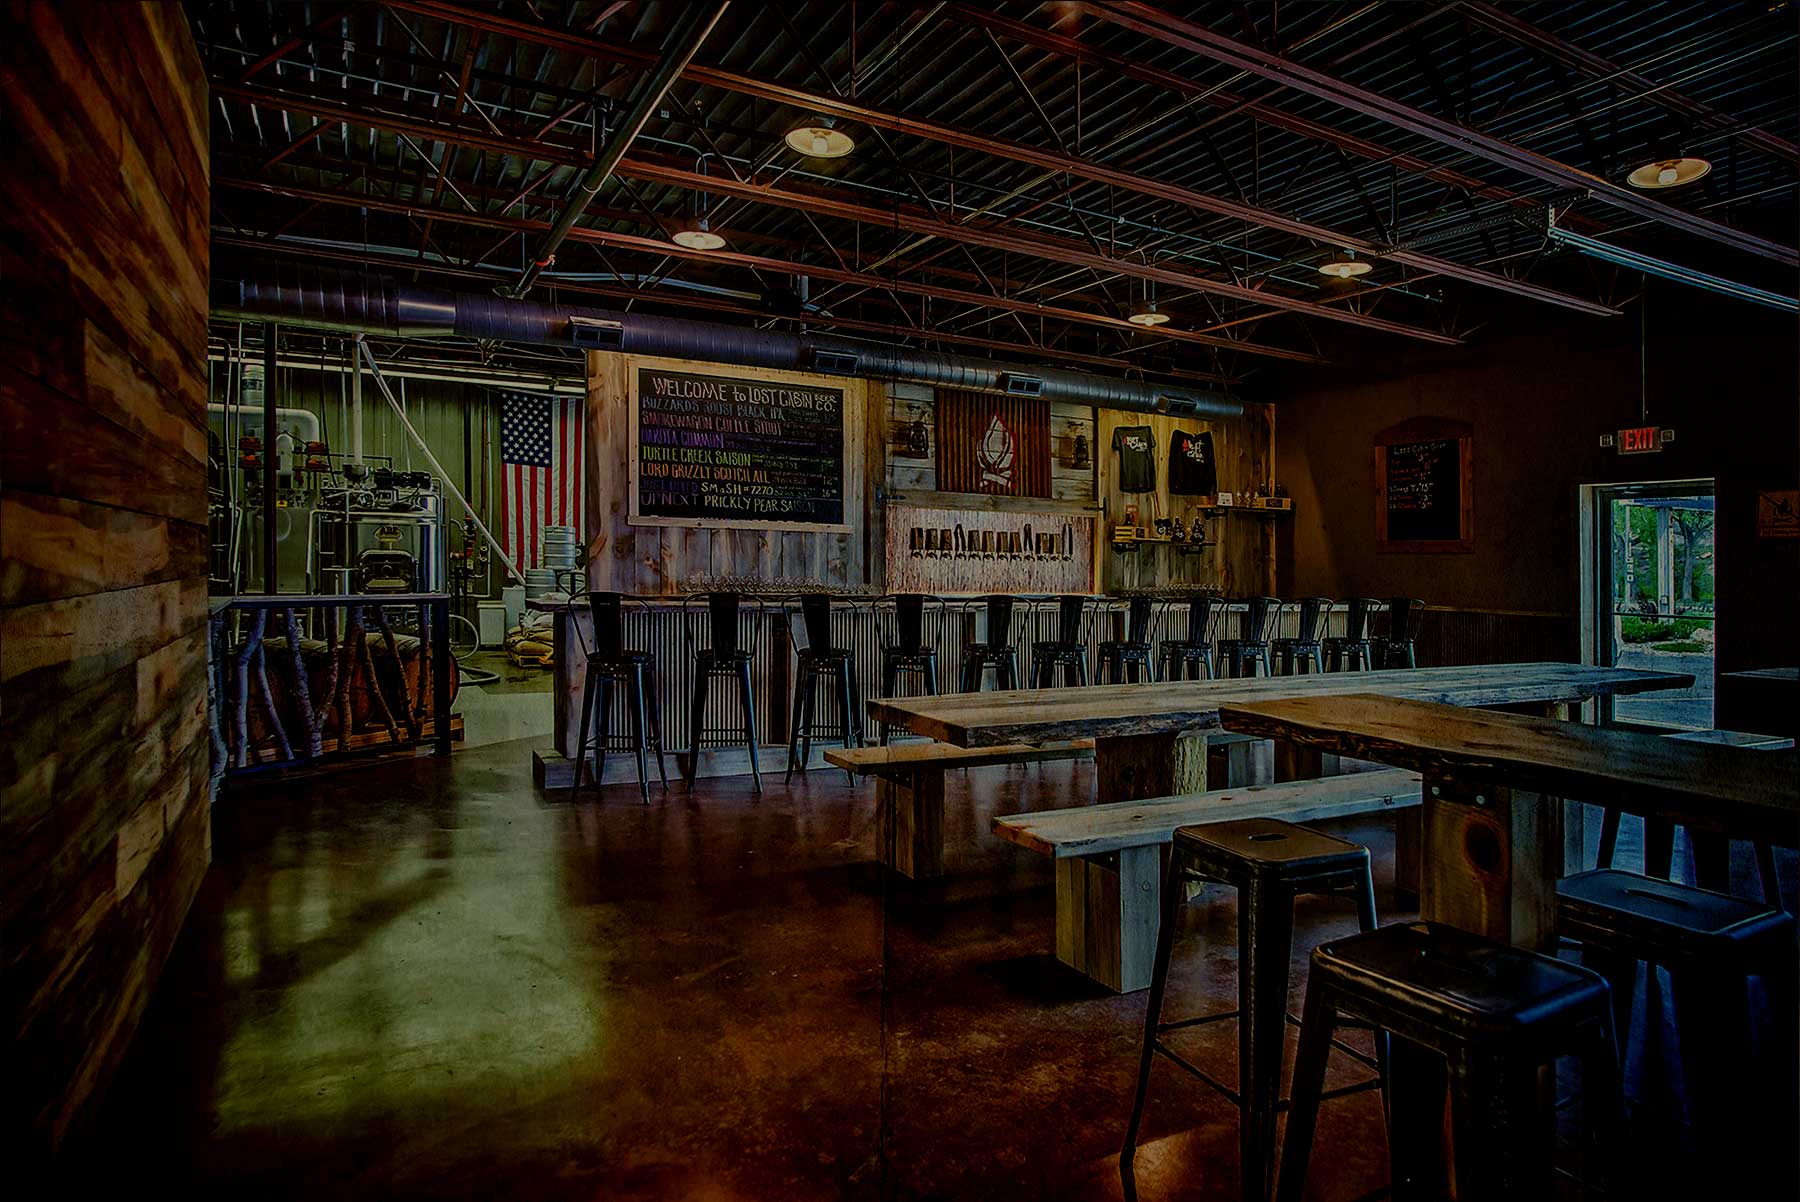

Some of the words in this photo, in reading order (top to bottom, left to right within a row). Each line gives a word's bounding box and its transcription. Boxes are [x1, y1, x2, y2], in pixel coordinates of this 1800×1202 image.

[651, 376, 728, 402] WELCOME
[748, 386, 777, 405] LOST
[779, 389, 813, 409] CABIN
[642, 396, 700, 413] BUZZARDS
[736, 403, 768, 420] BLACK
[1624, 428, 1654, 450] EXIT
[642, 445, 679, 462] TURTLE
[680, 448, 713, 464] CREEK
[714, 450, 751, 467] SAISON
[641, 461, 669, 479] LORD
[671, 463, 710, 480] GRIZZLY
[704, 493, 751, 511] PRICKLY
[753, 497, 780, 513] PEAR
